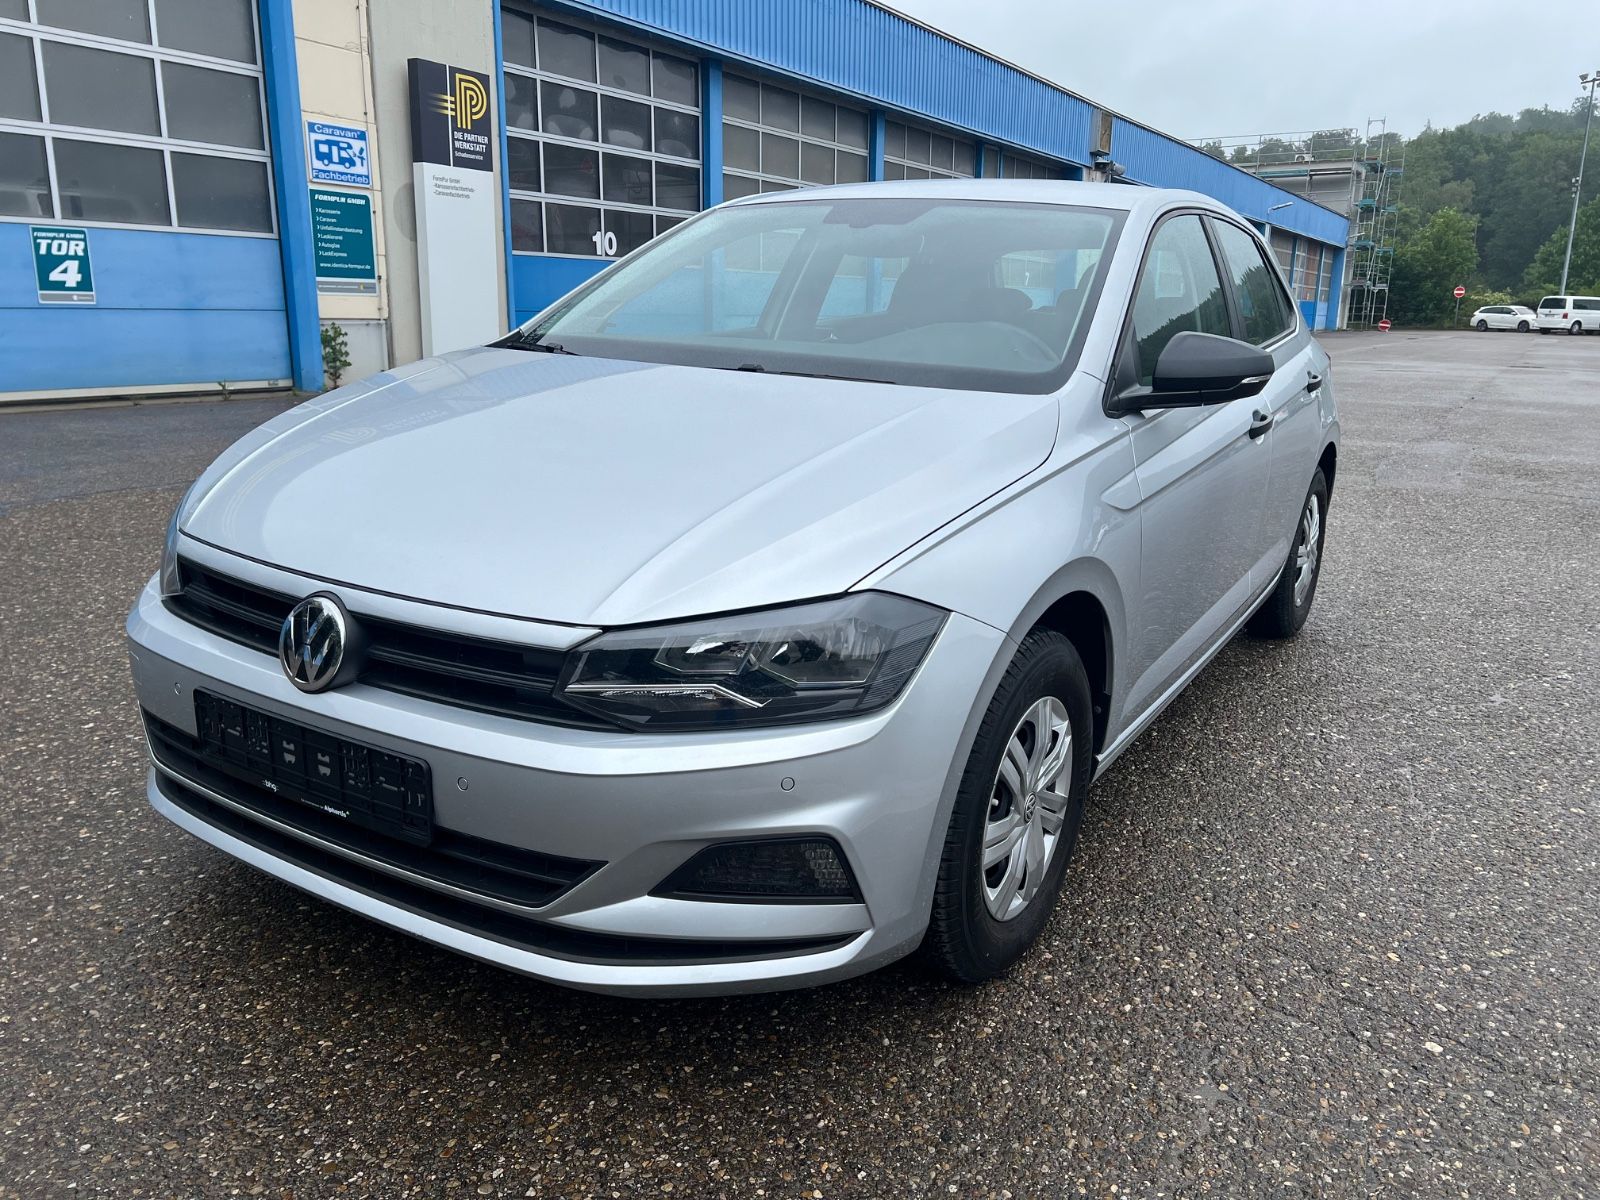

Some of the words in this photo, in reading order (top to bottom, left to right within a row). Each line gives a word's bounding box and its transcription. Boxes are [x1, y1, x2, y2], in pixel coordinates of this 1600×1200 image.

[453, 131, 464, 140] DIE
[463, 132, 489, 145] PARTNER
[454, 140, 487, 153] WERKSTATT
[454, 151, 484, 161] Schadenservice
[312, 169, 370, 184] Fachbetrieb
[36, 238, 86, 257] TOR
[592, 231, 618, 256] 10
[48, 259, 83, 288] 4
